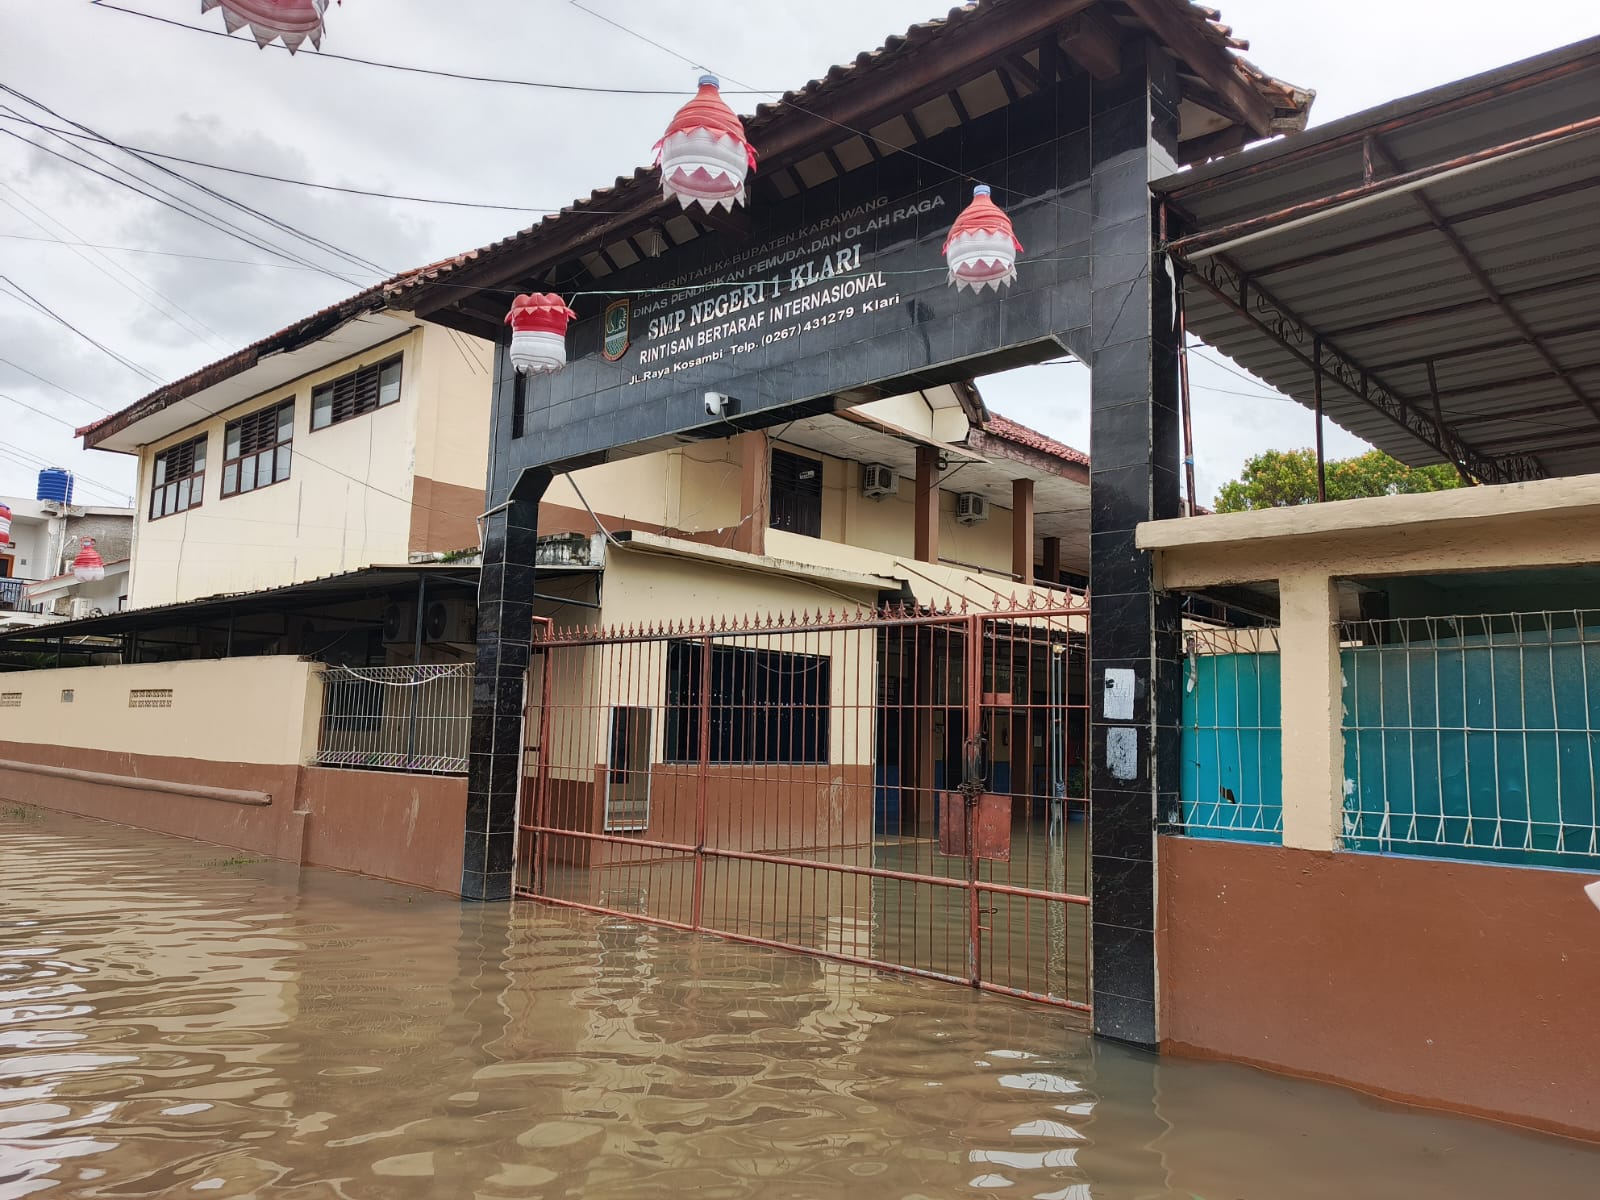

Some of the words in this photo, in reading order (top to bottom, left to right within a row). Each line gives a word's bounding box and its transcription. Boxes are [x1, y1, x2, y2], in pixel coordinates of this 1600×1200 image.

[633, 298, 668, 318] DINAS
[671, 270, 745, 305] PENDIDIKAN
[844, 214, 890, 239] OLAH
[893, 194, 946, 223] RAGA
[799, 196, 888, 239] KARAWANG
[639, 335, 694, 365] RINTISAN
[697, 311, 765, 347] BERTARAF
[769, 270, 887, 324] INTERNASIONAL
[648, 309, 686, 341] SMP
[690, 282, 765, 327] NEGERI
[771, 273, 782, 299] 1
[789, 243, 862, 292] KLARI
[673, 349, 723, 373] Kosambi
[730, 342, 759, 356] Telp.
[862, 293, 901, 314] Klari
